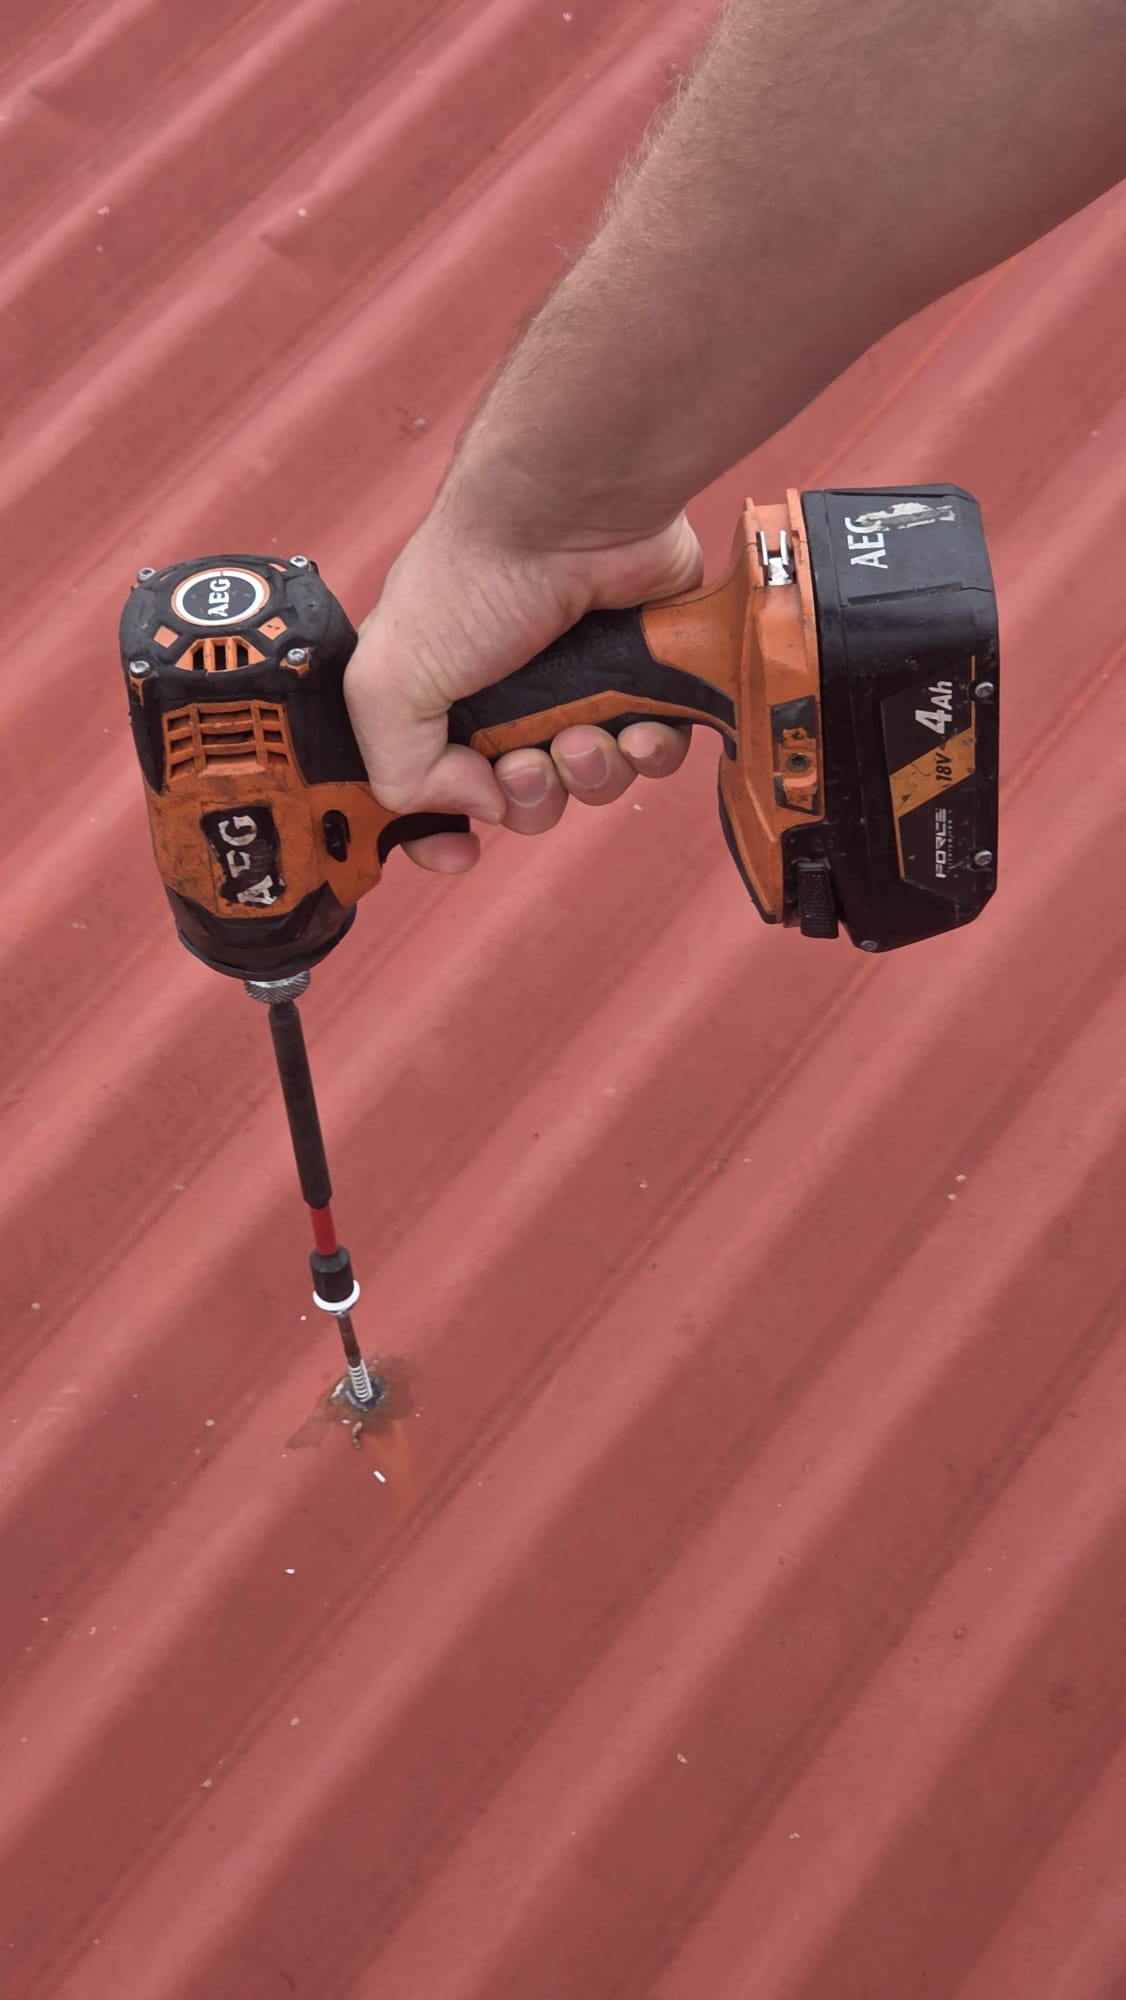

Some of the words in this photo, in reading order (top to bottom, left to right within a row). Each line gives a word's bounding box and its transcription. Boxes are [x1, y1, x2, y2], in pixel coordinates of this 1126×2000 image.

[208, 579, 231, 617] AEG
[935, 752, 952, 781] 18V
[935, 808, 947, 878] FORCE
